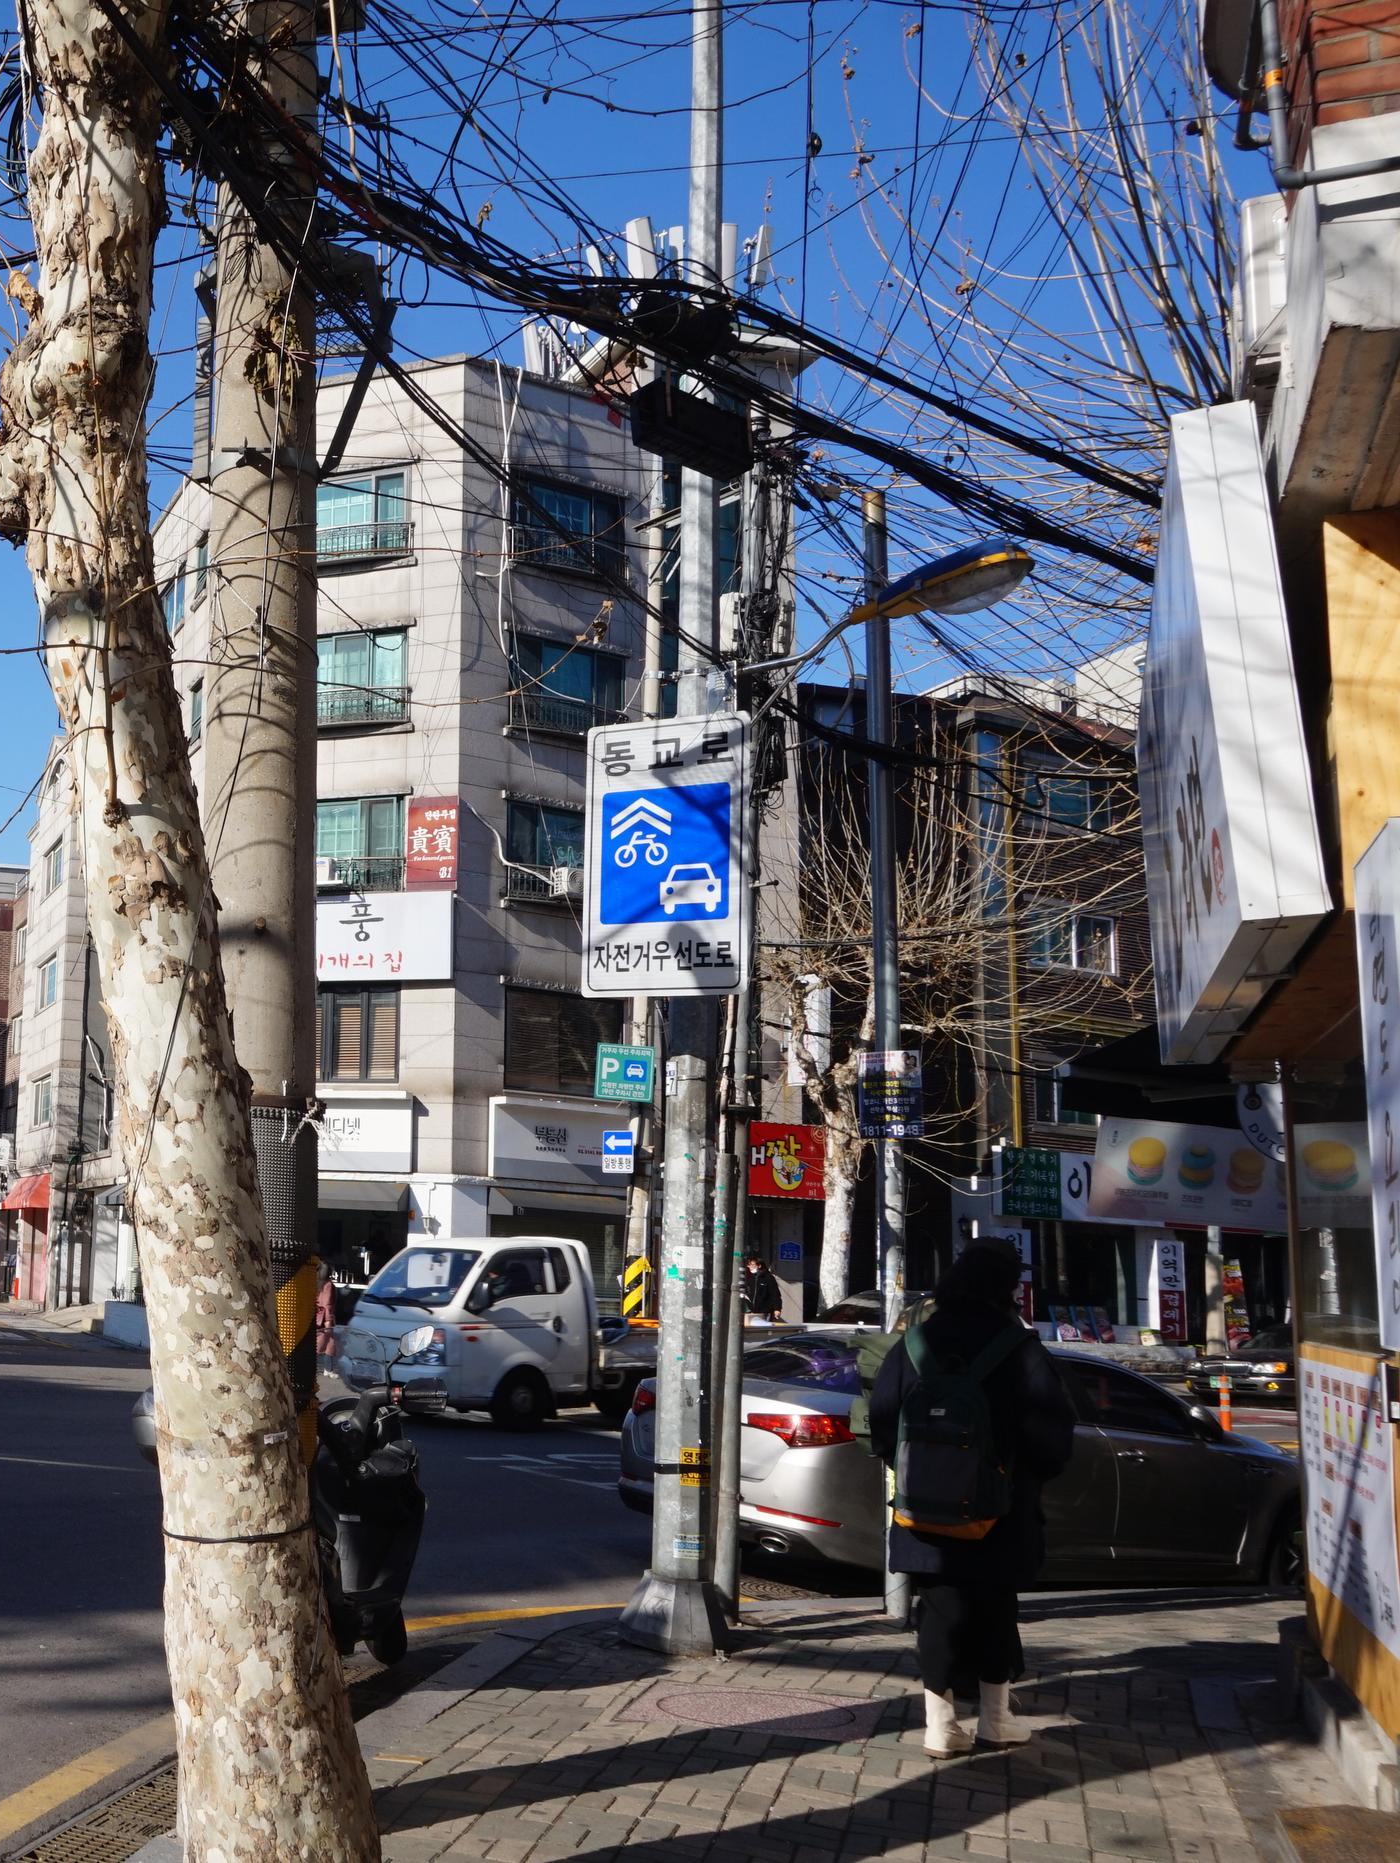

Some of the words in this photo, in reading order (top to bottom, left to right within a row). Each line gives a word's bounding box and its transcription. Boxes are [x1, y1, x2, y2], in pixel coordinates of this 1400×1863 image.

[600, 732, 733, 777] 동교로
[409, 825, 456, 854] 貴賓
[439, 867, 453, 878] B1
[339, 904, 384, 942] 풍
[383, 951, 403, 973] 집
[593, 939, 734, 973] 자전거우선도로
[602, 1057, 619, 1080] P
[862, 1125, 920, 1137] 1811-1948
[604, 1158, 633, 1170] 일방통행
